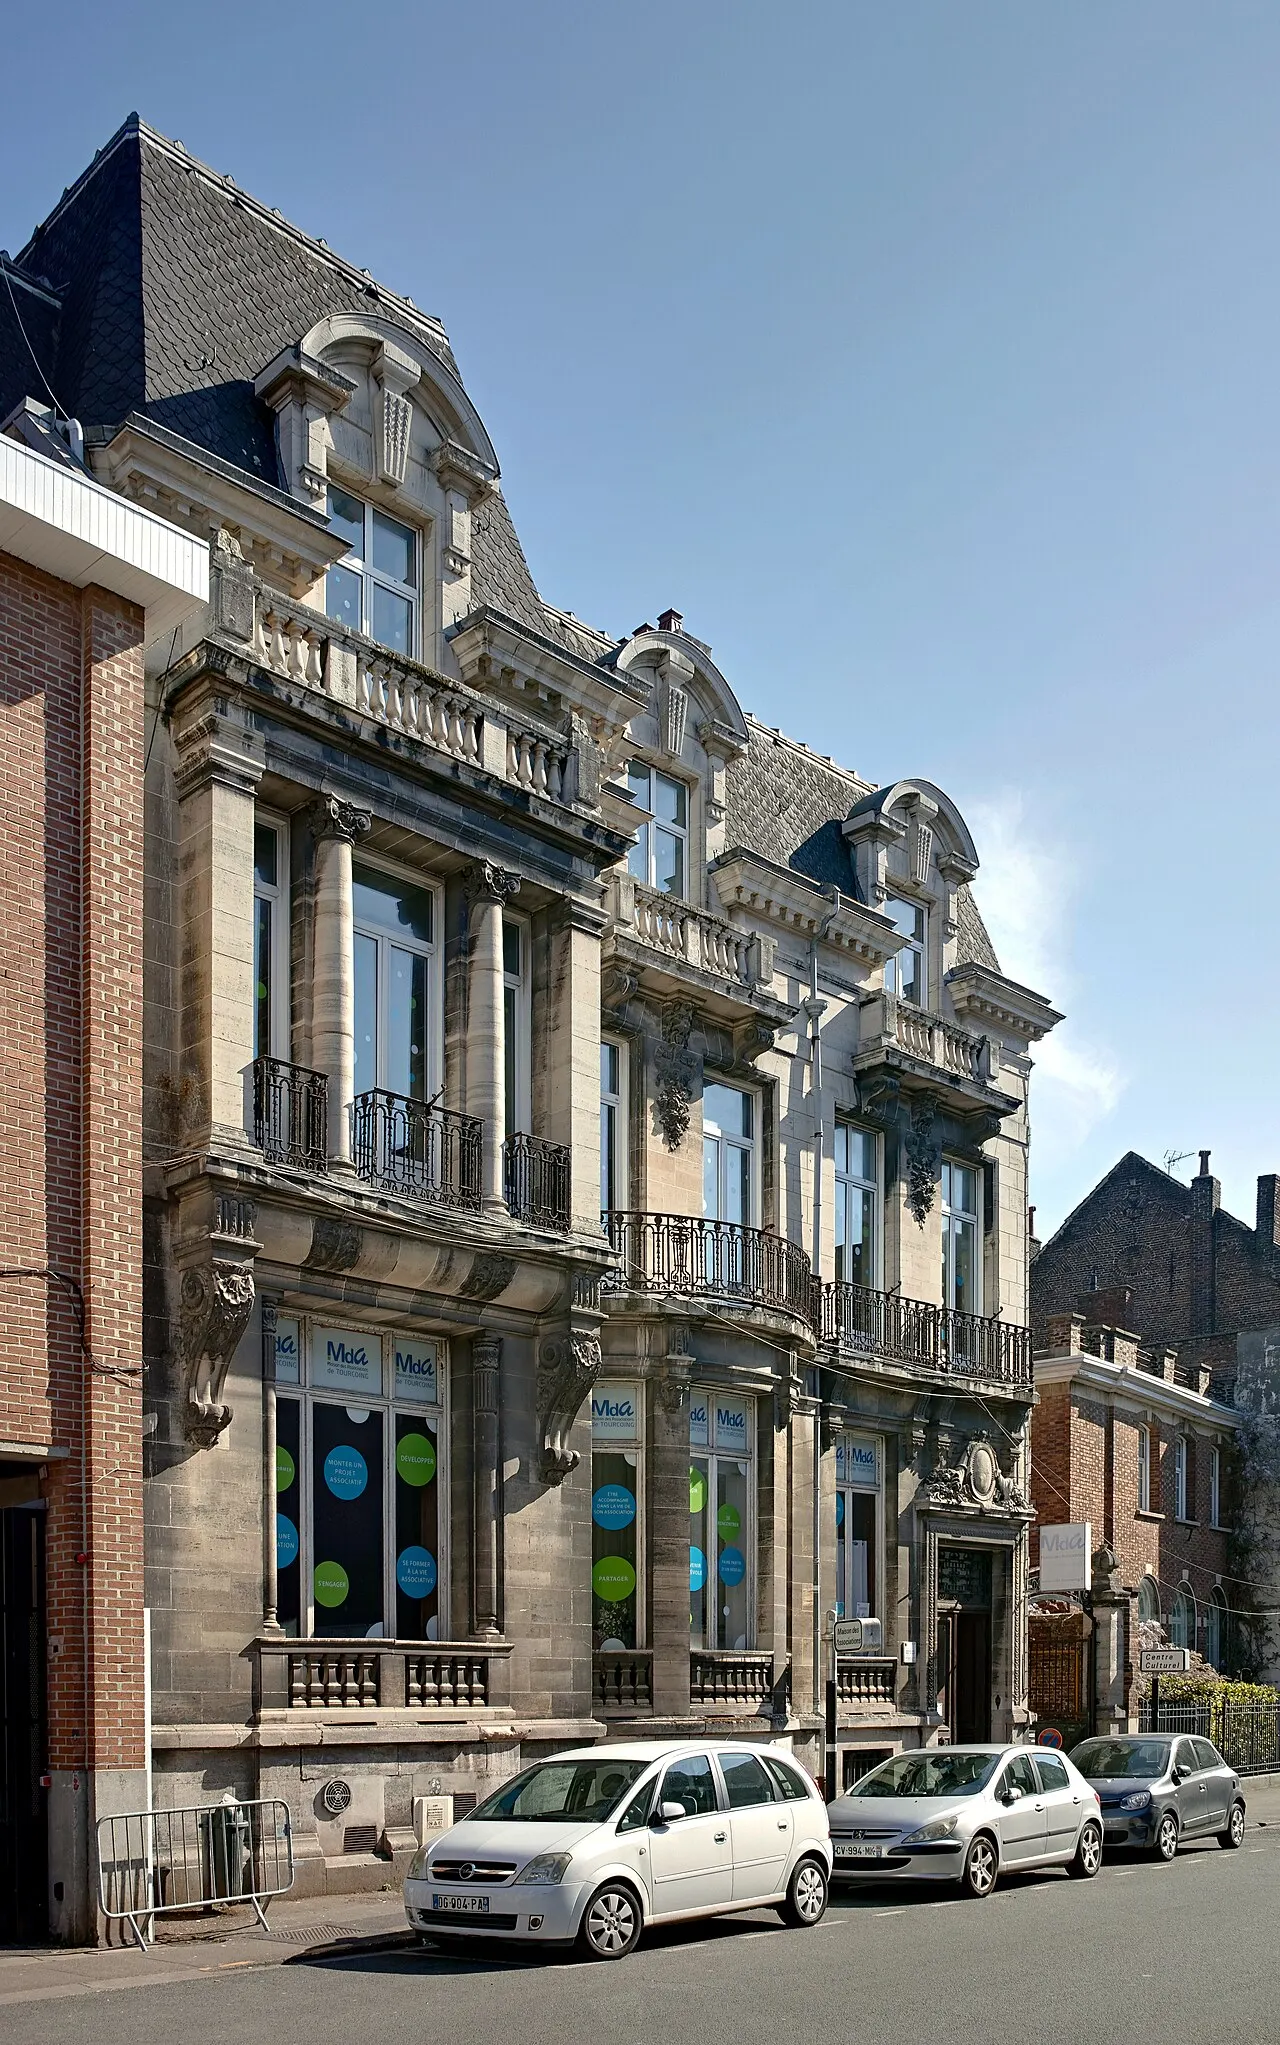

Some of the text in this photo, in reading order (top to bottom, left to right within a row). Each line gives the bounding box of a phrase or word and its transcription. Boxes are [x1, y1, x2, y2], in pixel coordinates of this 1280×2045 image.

[276, 1335, 296, 1354] da
[327, 1341, 368, 1366] Mda
[276, 1360, 297, 1369] RCOING
[396, 1352, 434, 1376] Mda
[336, 1369, 369, 1380] TOURCOING
[404, 1380, 435, 1390] TOURCOING
[592, 1399, 634, 1416] Mda
[690, 1407, 707, 1422] da
[717, 1409, 745, 1428] Mda
[852, 1447, 875, 1464] Mda
[328, 1459, 353, 1468] MONTER
[335, 1468, 356, 1477] PROJET
[329, 1476, 362, 1486] ASSOCIATIF
[1041, 1533, 1085, 1552] Mda
[402, 1559, 431, 1568] SE FORMER
[318, 1580, 347, 1588] S'ENGAGER
[401, 1576, 434, 1584] ASSOCIATIVE
[837, 1626, 860, 1635] Maison des
[1145, 1653, 1174, 1661] Centre
[1145, 1661, 1180, 1669] Culturel
